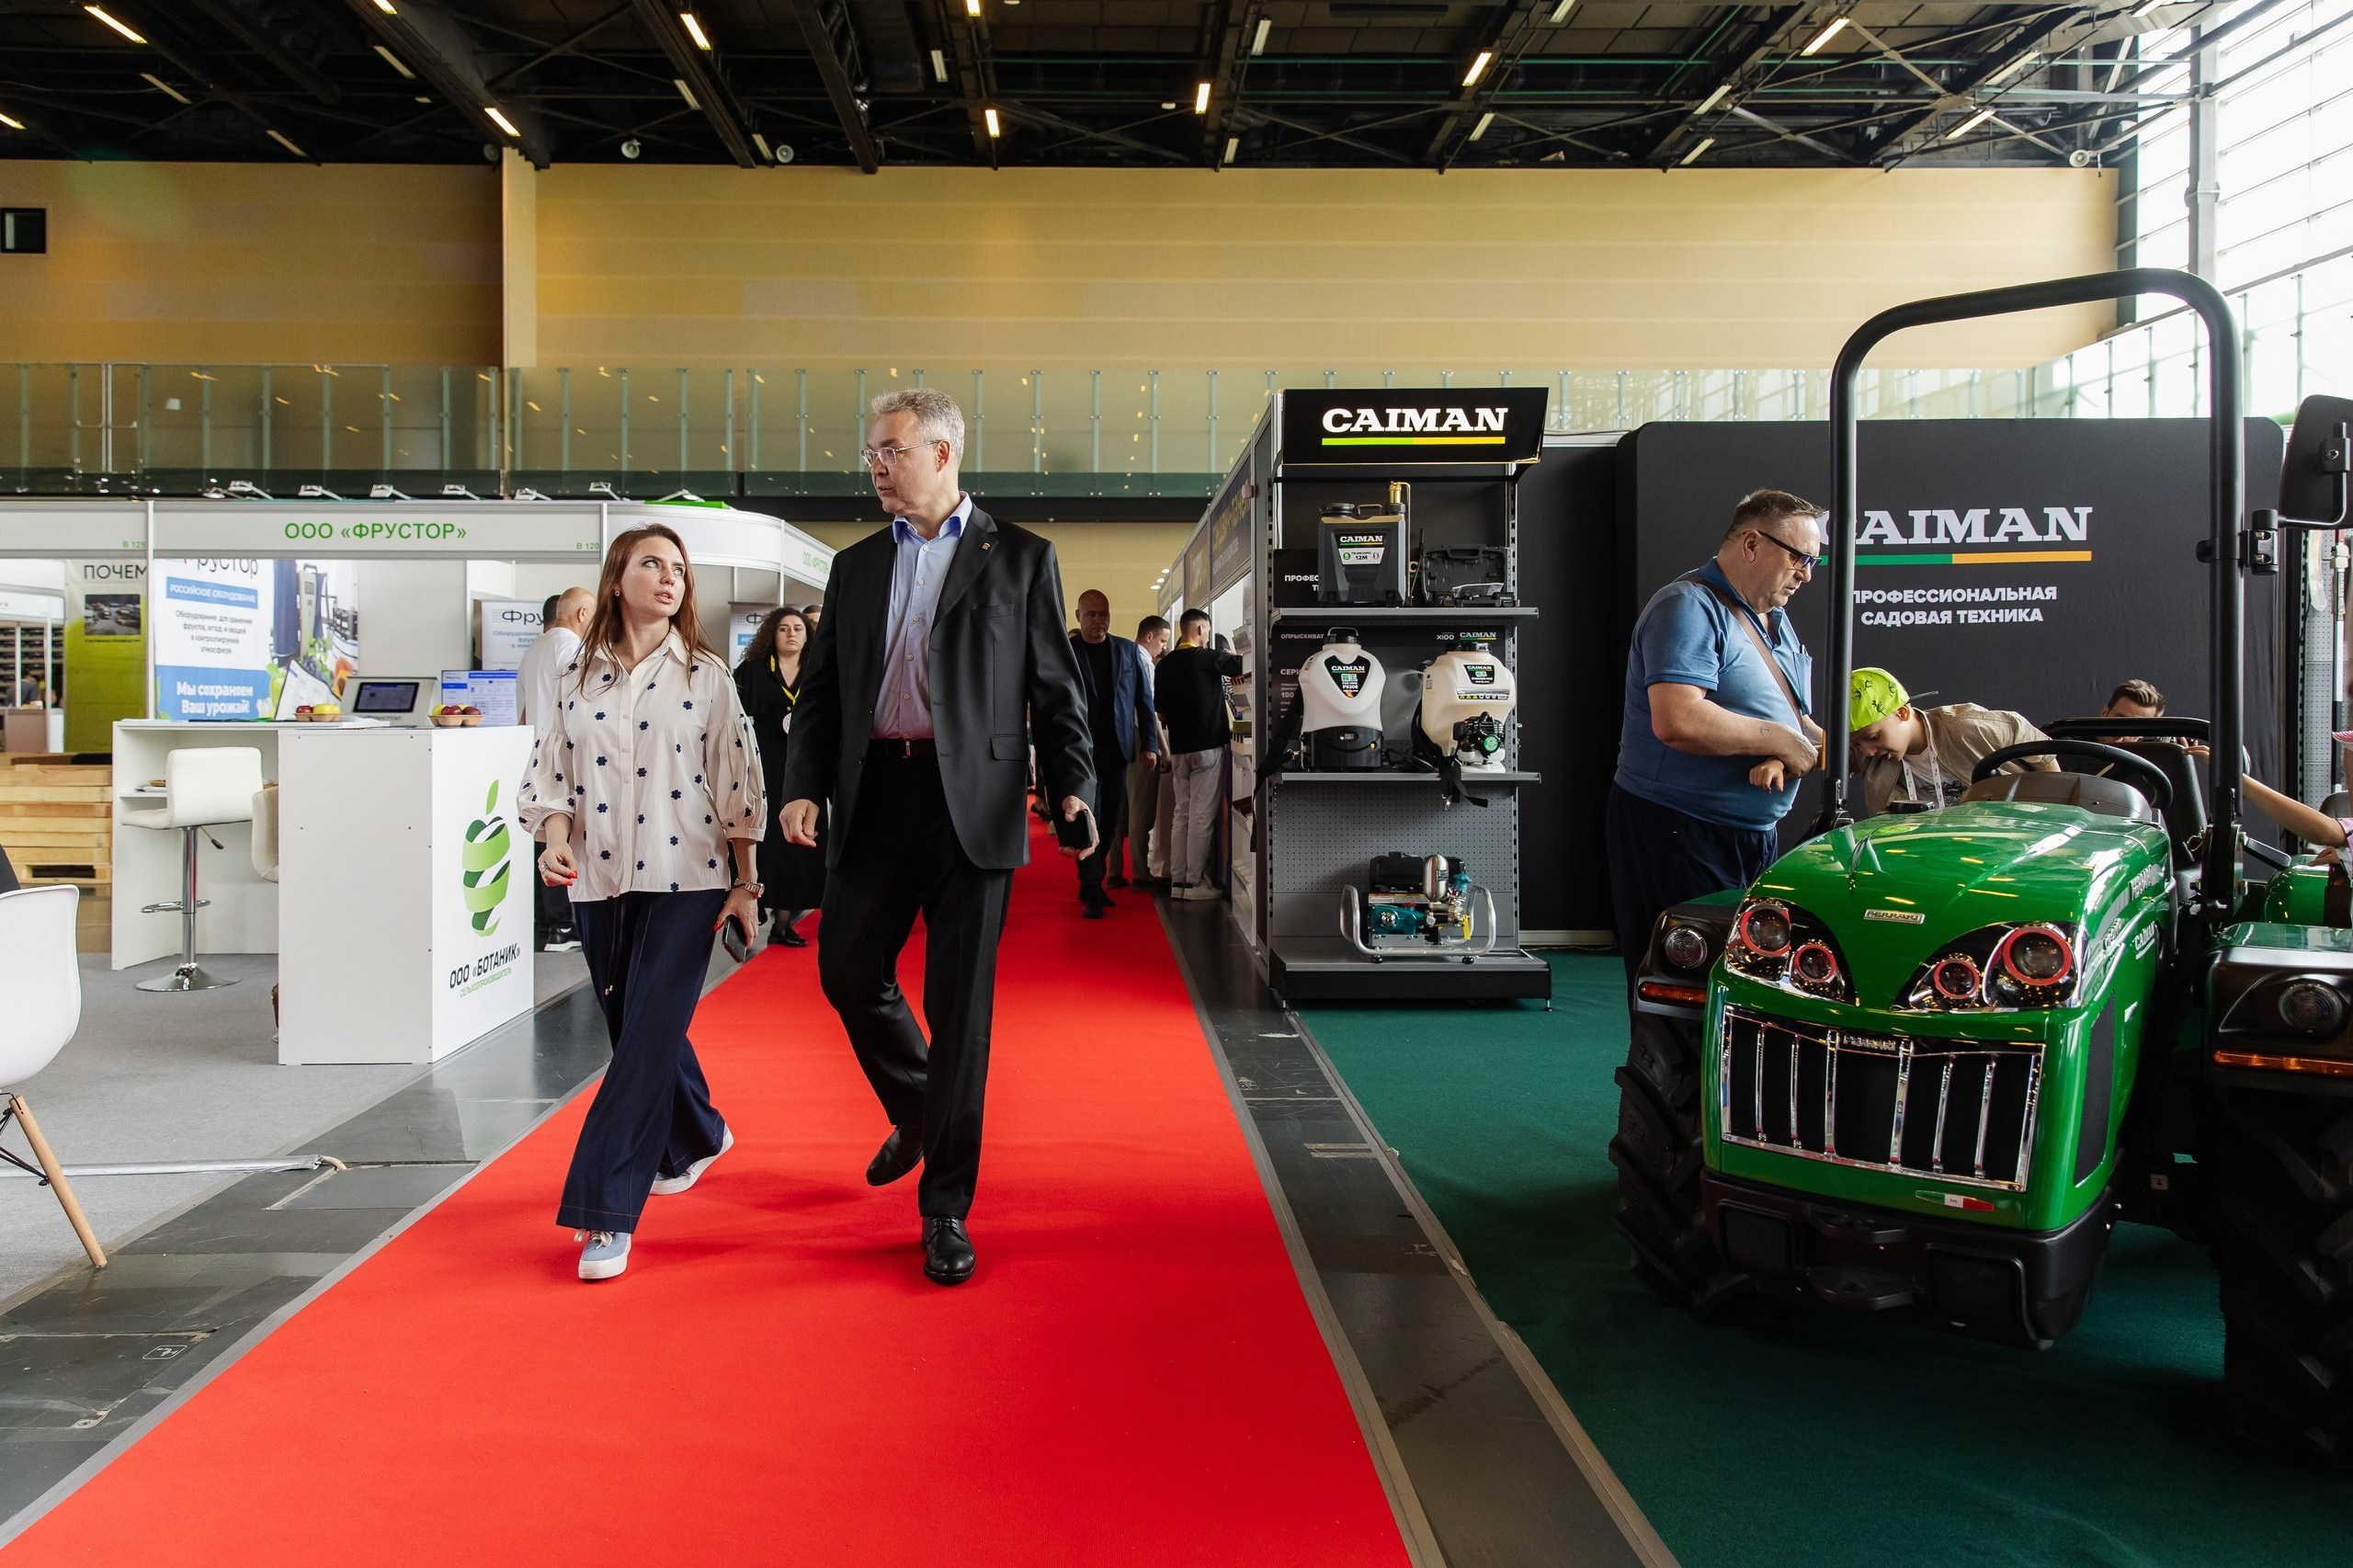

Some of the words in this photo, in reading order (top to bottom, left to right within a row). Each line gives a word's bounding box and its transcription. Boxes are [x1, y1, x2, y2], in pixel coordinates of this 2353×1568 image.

[1322, 407, 1509, 433] CAIMAN
[285, 523, 333, 540] ООО
[341, 522, 467, 540] «ФРУСТОР»
[1339, 535, 1384, 543] CAIMAN
[131, 540, 147, 549] 125
[1860, 610, 1952, 627] САДОВАЯ
[1956, 608, 2044, 624] ТЕХНИКА
[176, 681, 197, 696] Мы
[198, 684, 254, 699] сохраняем
[181, 699, 205, 713] Ваш
[1866, 911, 1920, 921] FERRARI
[449, 964, 470, 989] ООО
[472, 943, 521, 976] «БОТАНИК»
